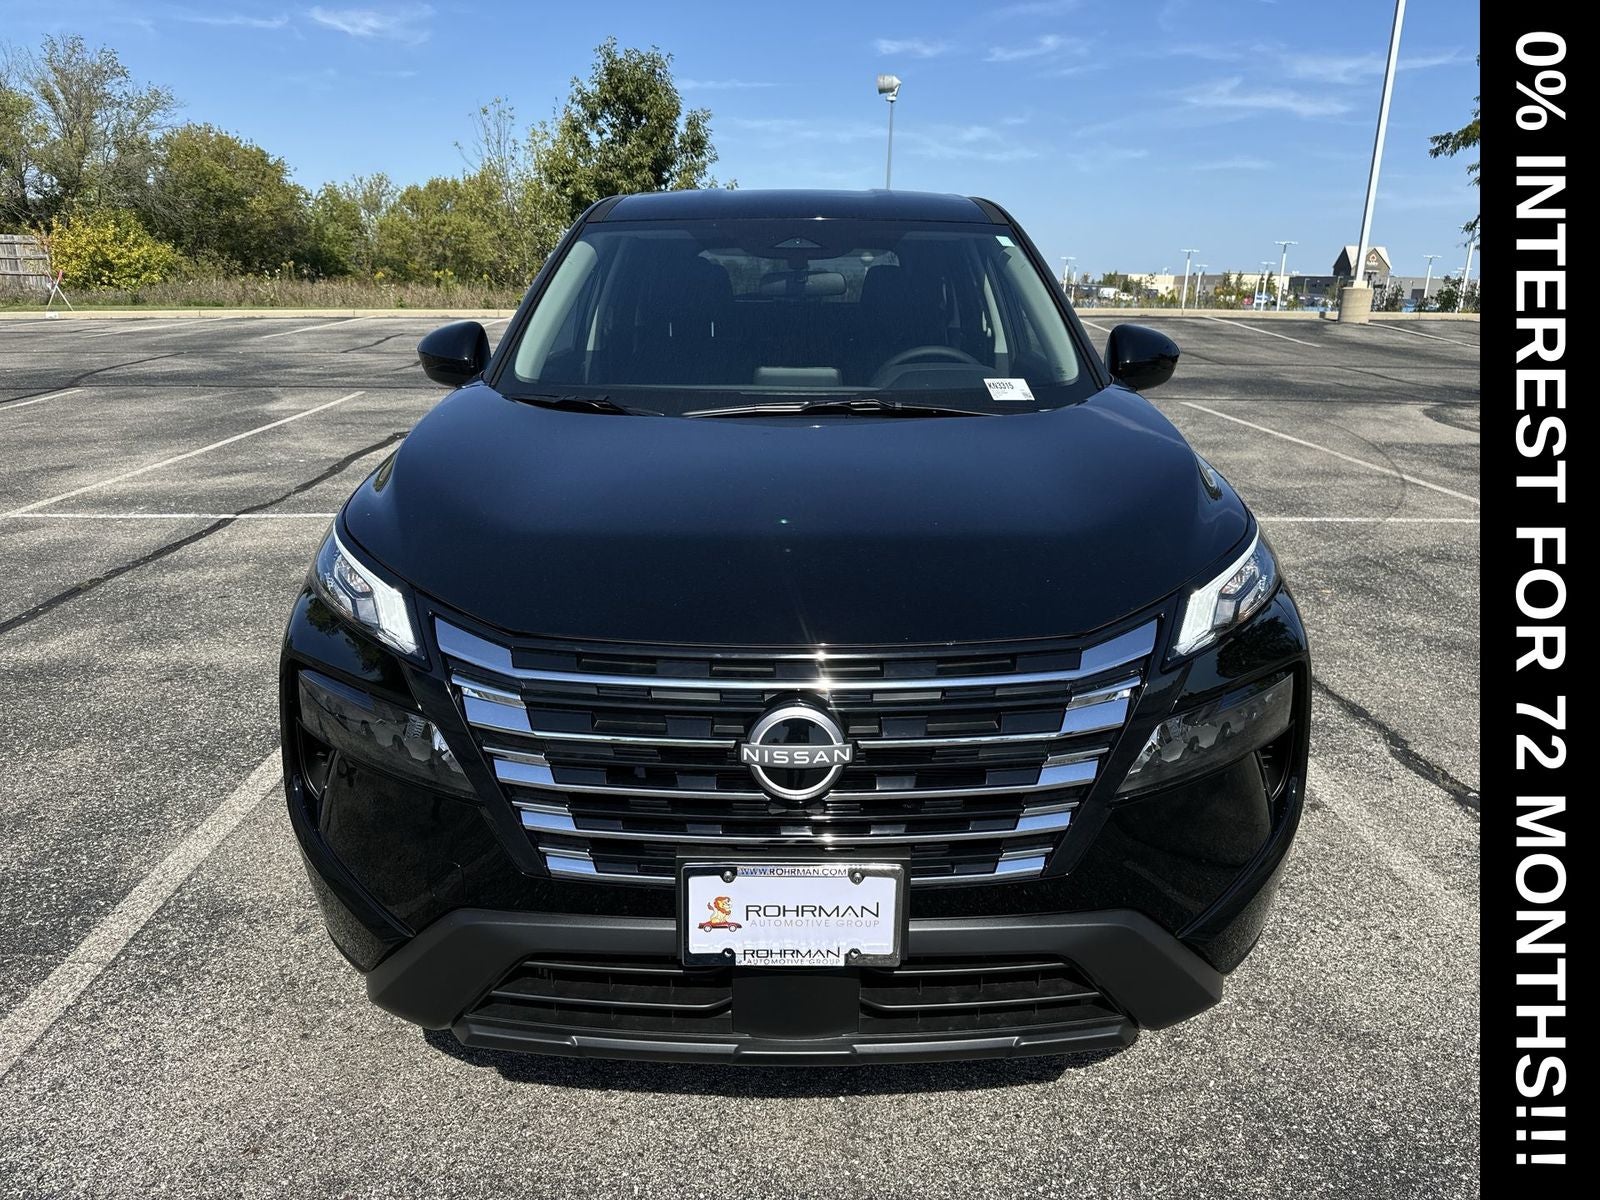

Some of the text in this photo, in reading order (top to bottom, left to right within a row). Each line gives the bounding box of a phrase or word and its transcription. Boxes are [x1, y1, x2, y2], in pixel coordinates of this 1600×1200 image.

[743, 747, 850, 764] NISSAN
[740, 867, 847, 876] WWW.ROHRMAN.COM
[745, 902, 880, 921] ROHRMAN
[750, 919, 880, 928] AUTOMOTIVE GROUP
[743, 946, 840, 961] ROHRMAN
